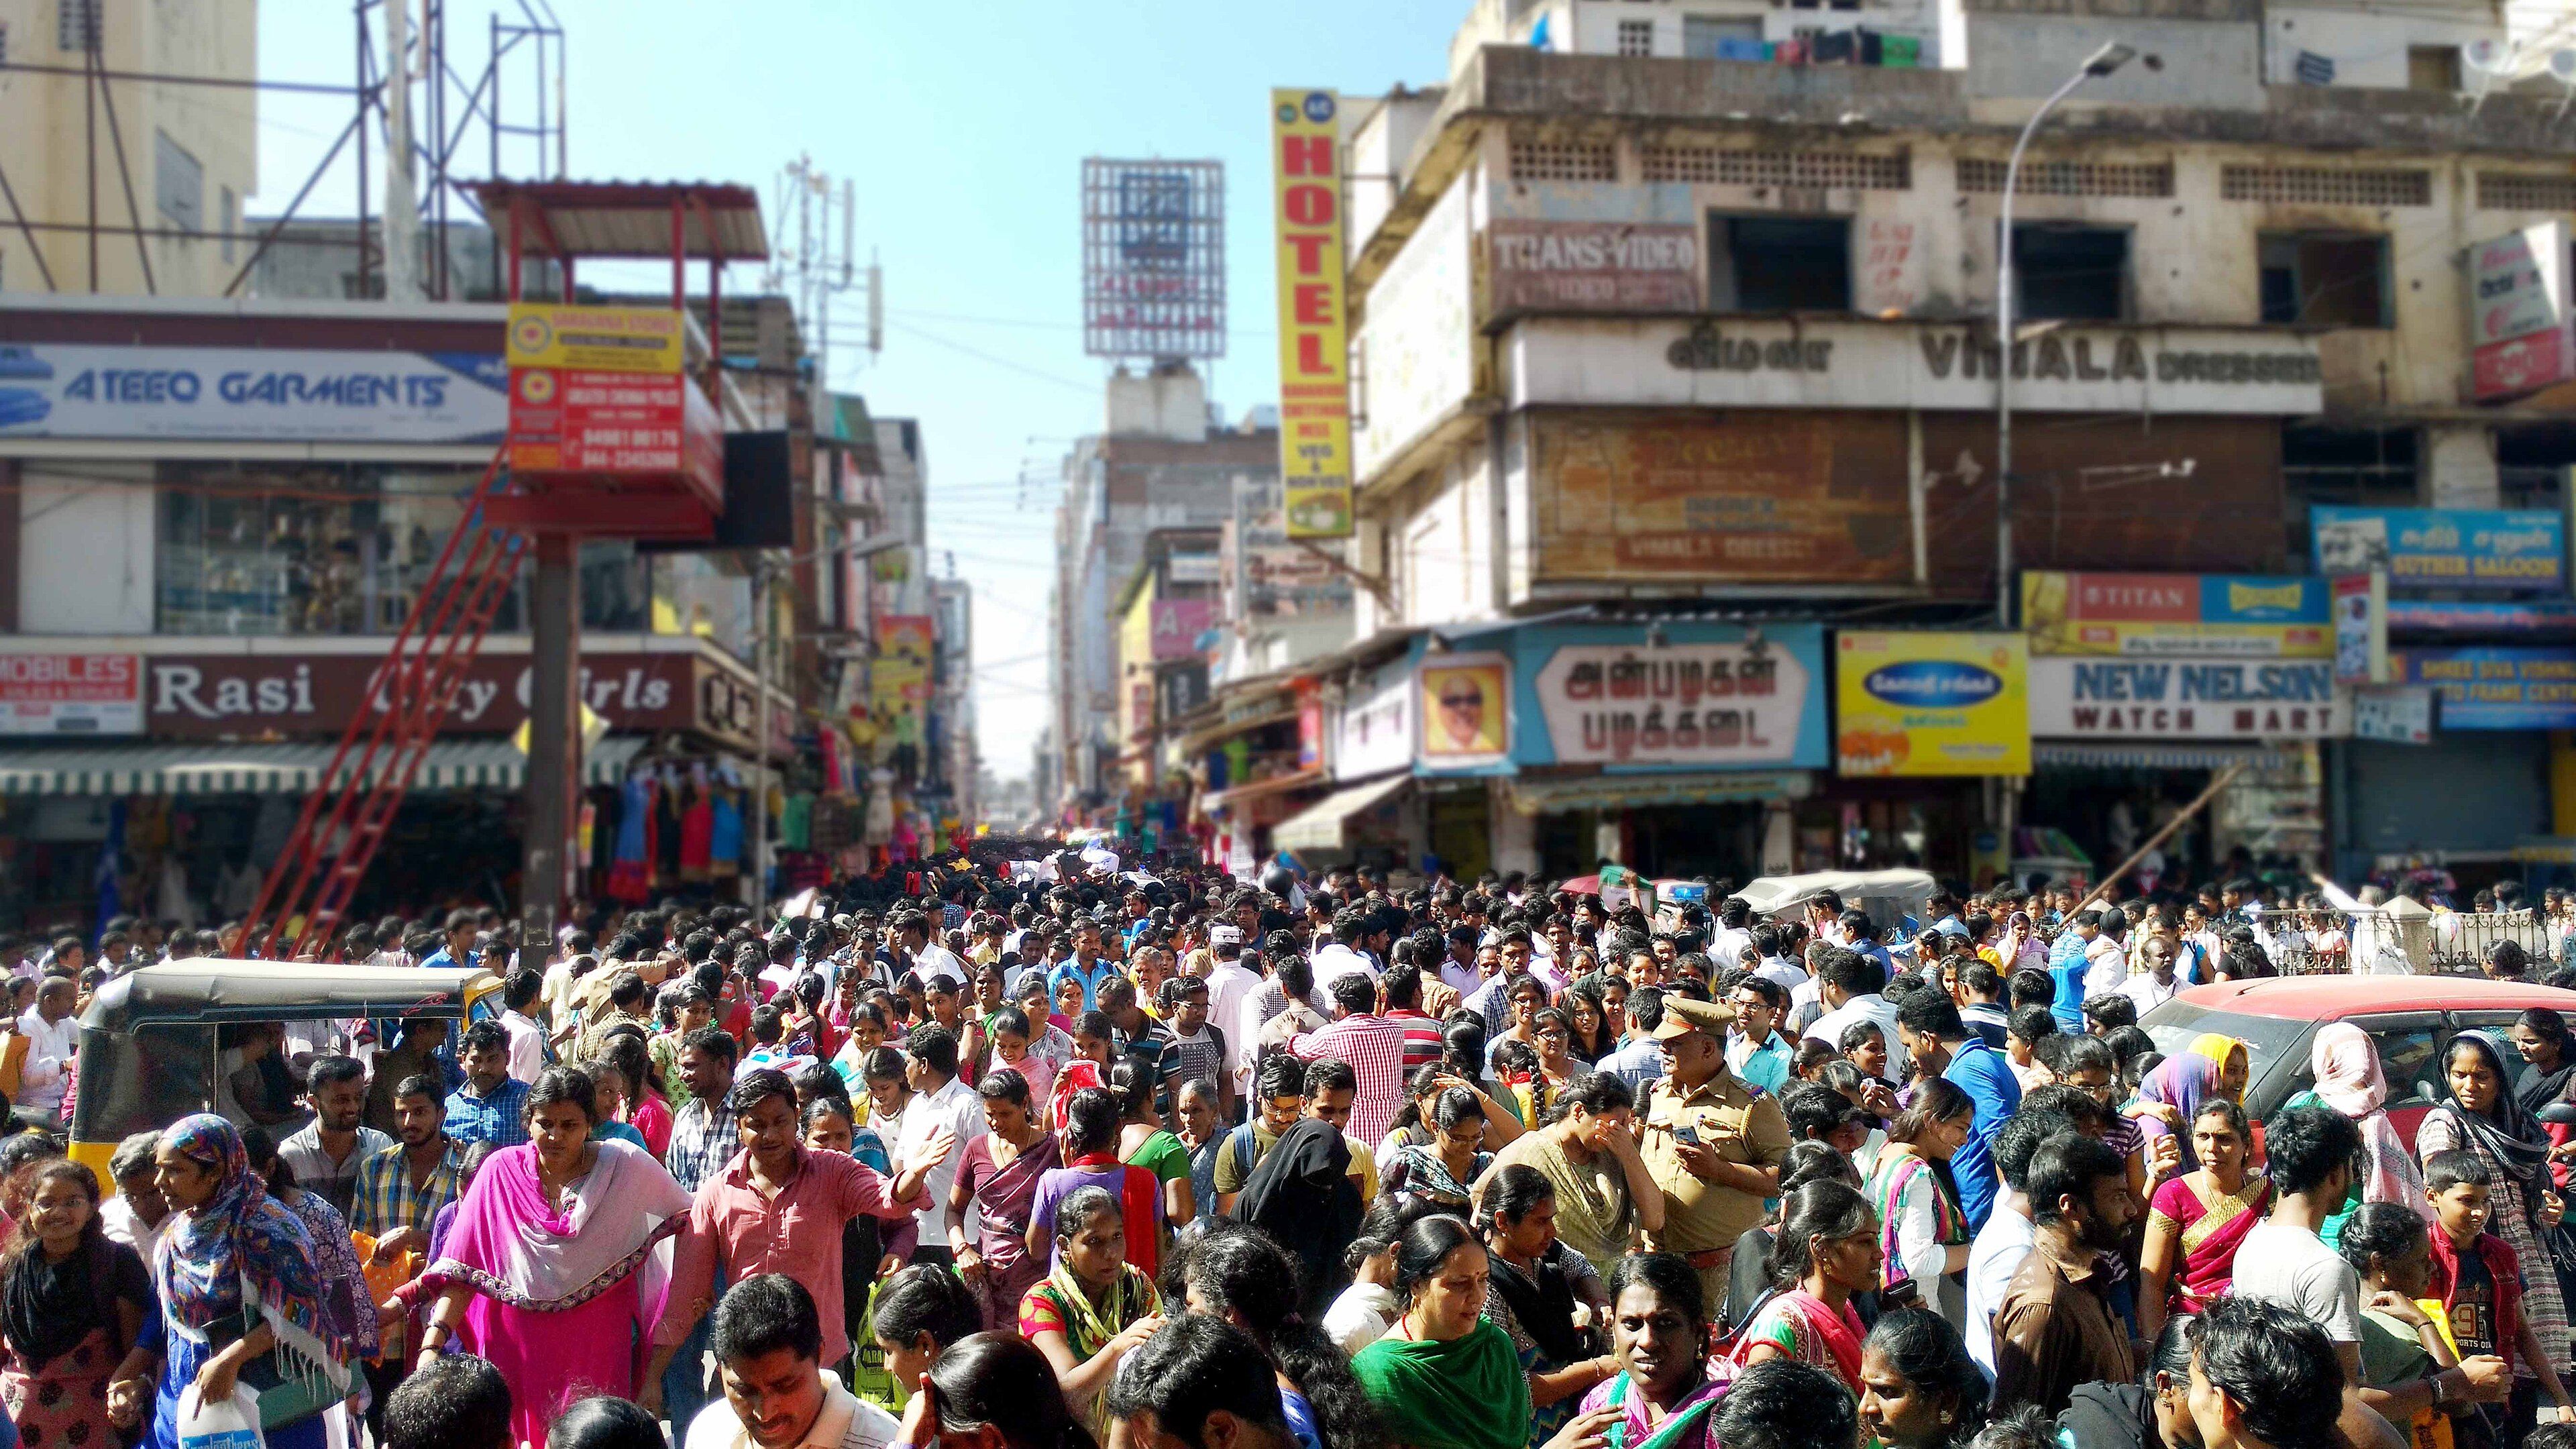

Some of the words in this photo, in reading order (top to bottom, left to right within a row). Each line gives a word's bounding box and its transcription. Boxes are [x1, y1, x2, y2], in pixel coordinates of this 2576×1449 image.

[1282, 136, 1334, 374] HOTEL
[2156, 352, 2320, 384] DRESSES
[218, 372, 449, 406] GARMENTS
[1298, 445, 1333, 458] VEG
[2475, 557, 2558, 577] SALOON
[2108, 588, 2184, 606] TITAN
[154, 665, 314, 718] Rasi
[2074, 664, 2171, 700] NEW
[2181, 664, 2331, 701] NELSON
[2073, 708, 2194, 731] WATCH
[2234, 708, 2332, 731] MART
[2455, 1339, 2479, 1348] PORTS
